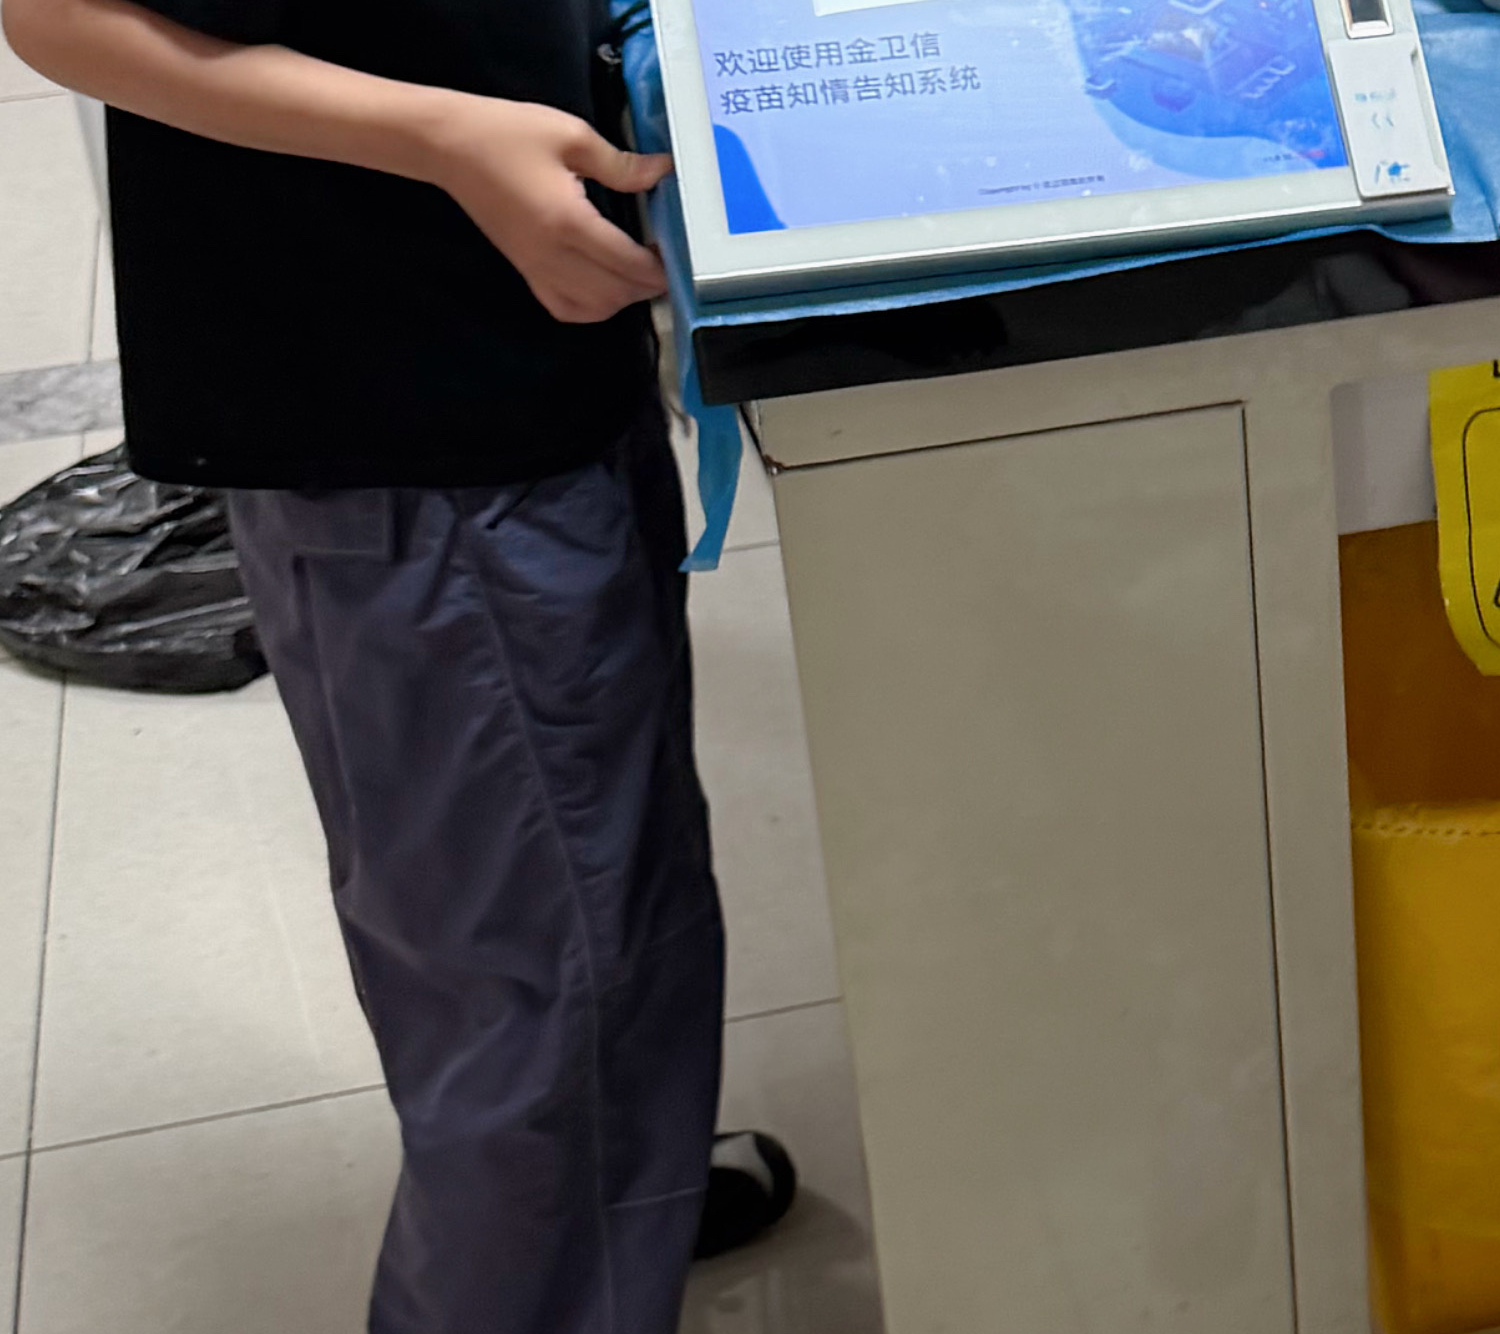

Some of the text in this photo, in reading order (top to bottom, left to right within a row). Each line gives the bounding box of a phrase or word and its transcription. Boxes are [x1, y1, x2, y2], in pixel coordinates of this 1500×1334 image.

[714, 32, 941, 77] 欢迎使用金卫信
[720, 64, 981, 115] 疫苗知情告知系统
